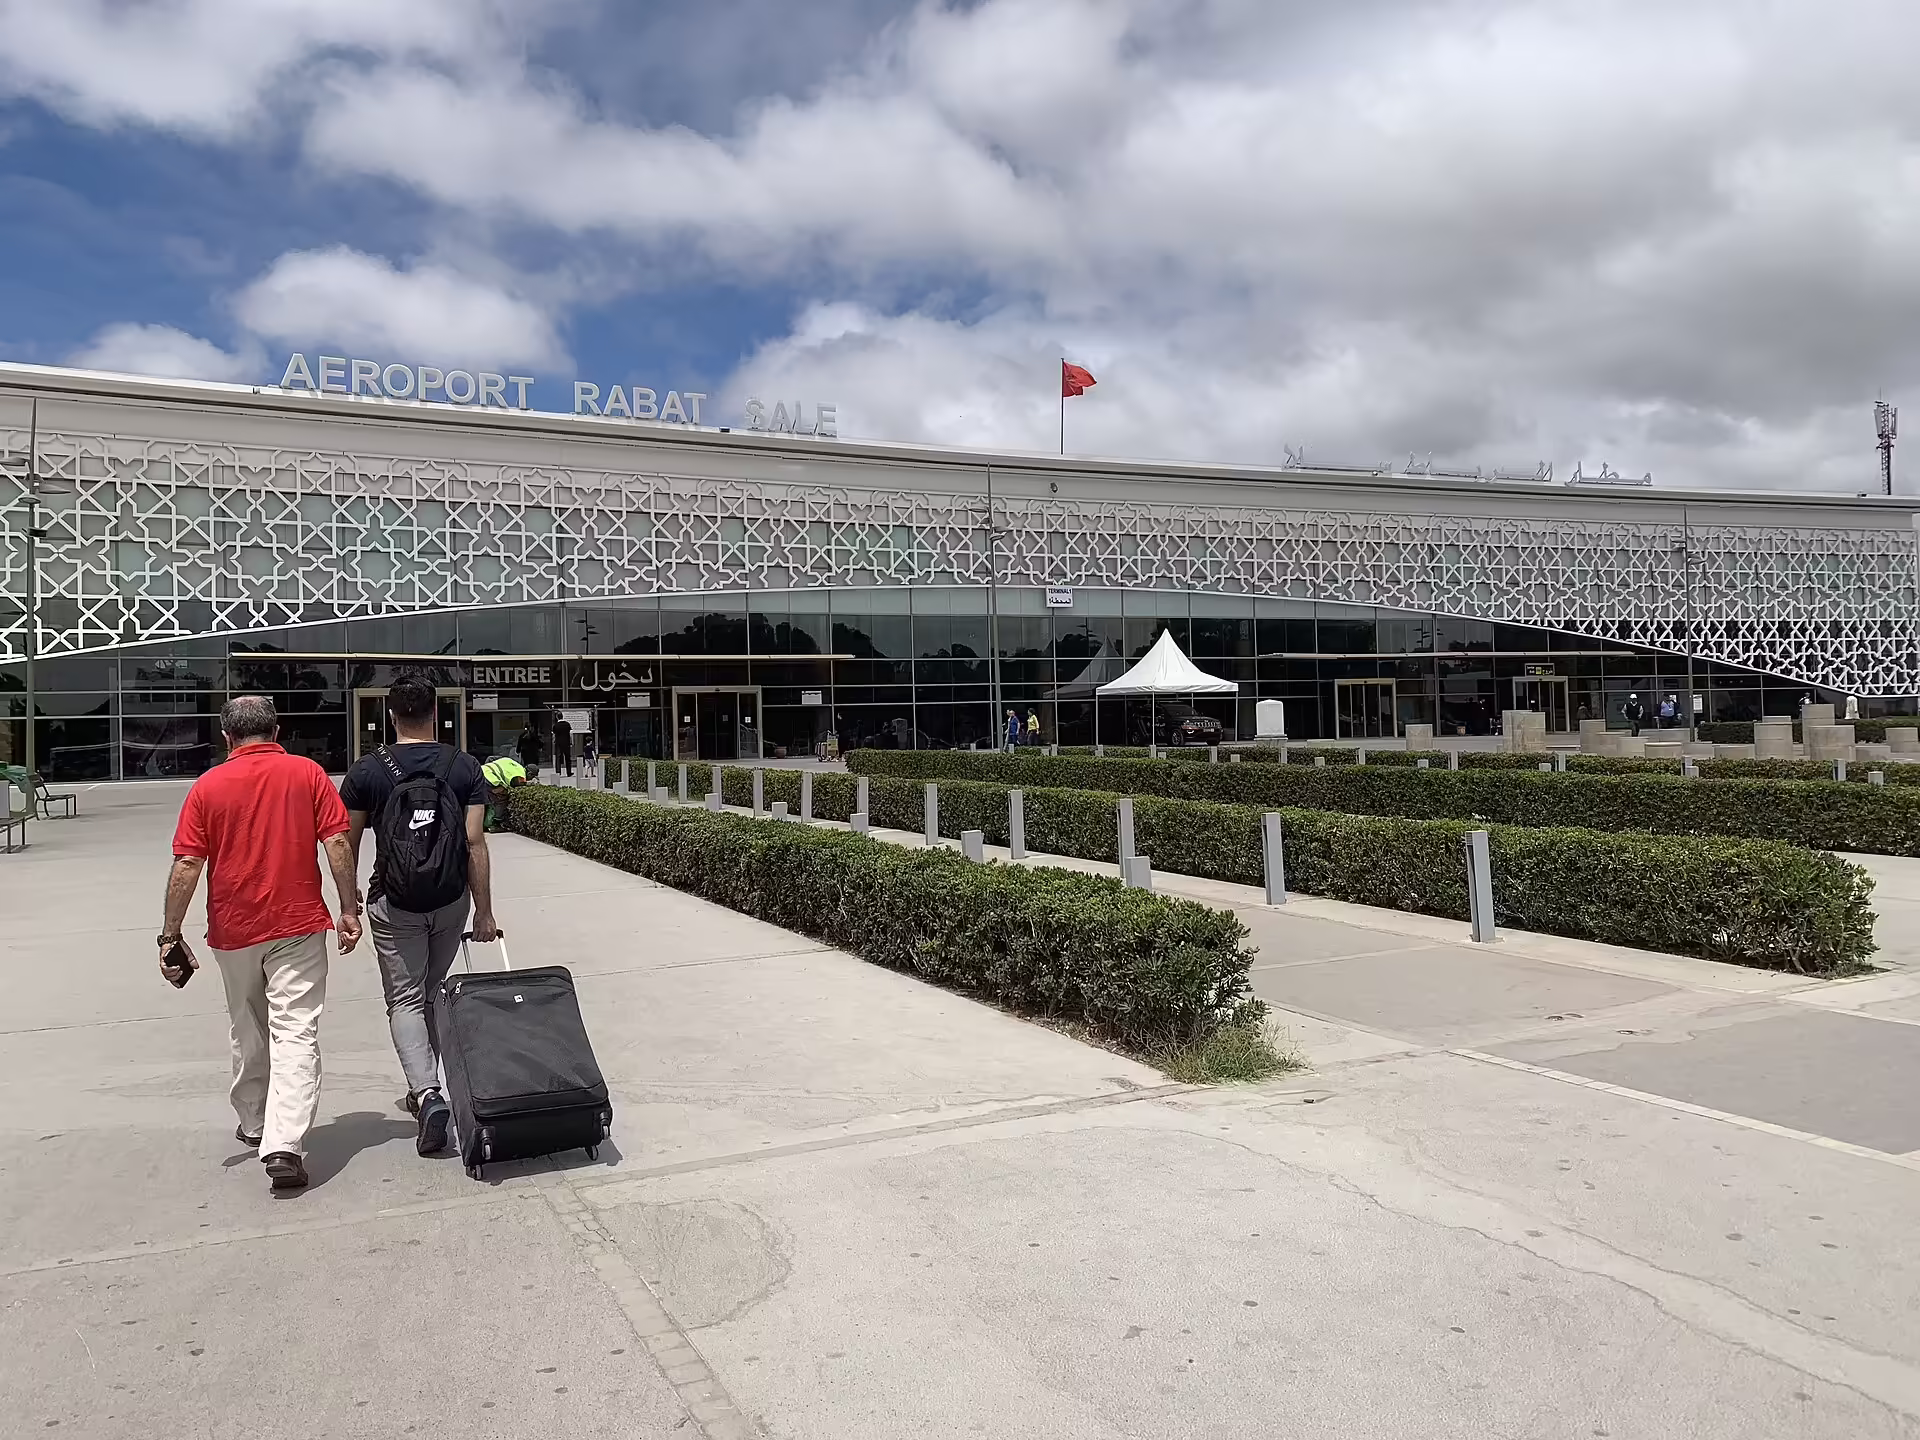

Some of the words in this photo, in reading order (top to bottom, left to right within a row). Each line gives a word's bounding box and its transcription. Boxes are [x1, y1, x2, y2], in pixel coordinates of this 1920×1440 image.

[280, 352, 535, 410] AEROPORT
[573, 381, 707, 425] RABAT
[744, 398, 838, 438] SALE
[473, 667, 550, 684] ENTREE
[580, 660, 653, 692] دخول
[384, 756, 402, 777] NIKE
[413, 809, 436, 821] NIKE
